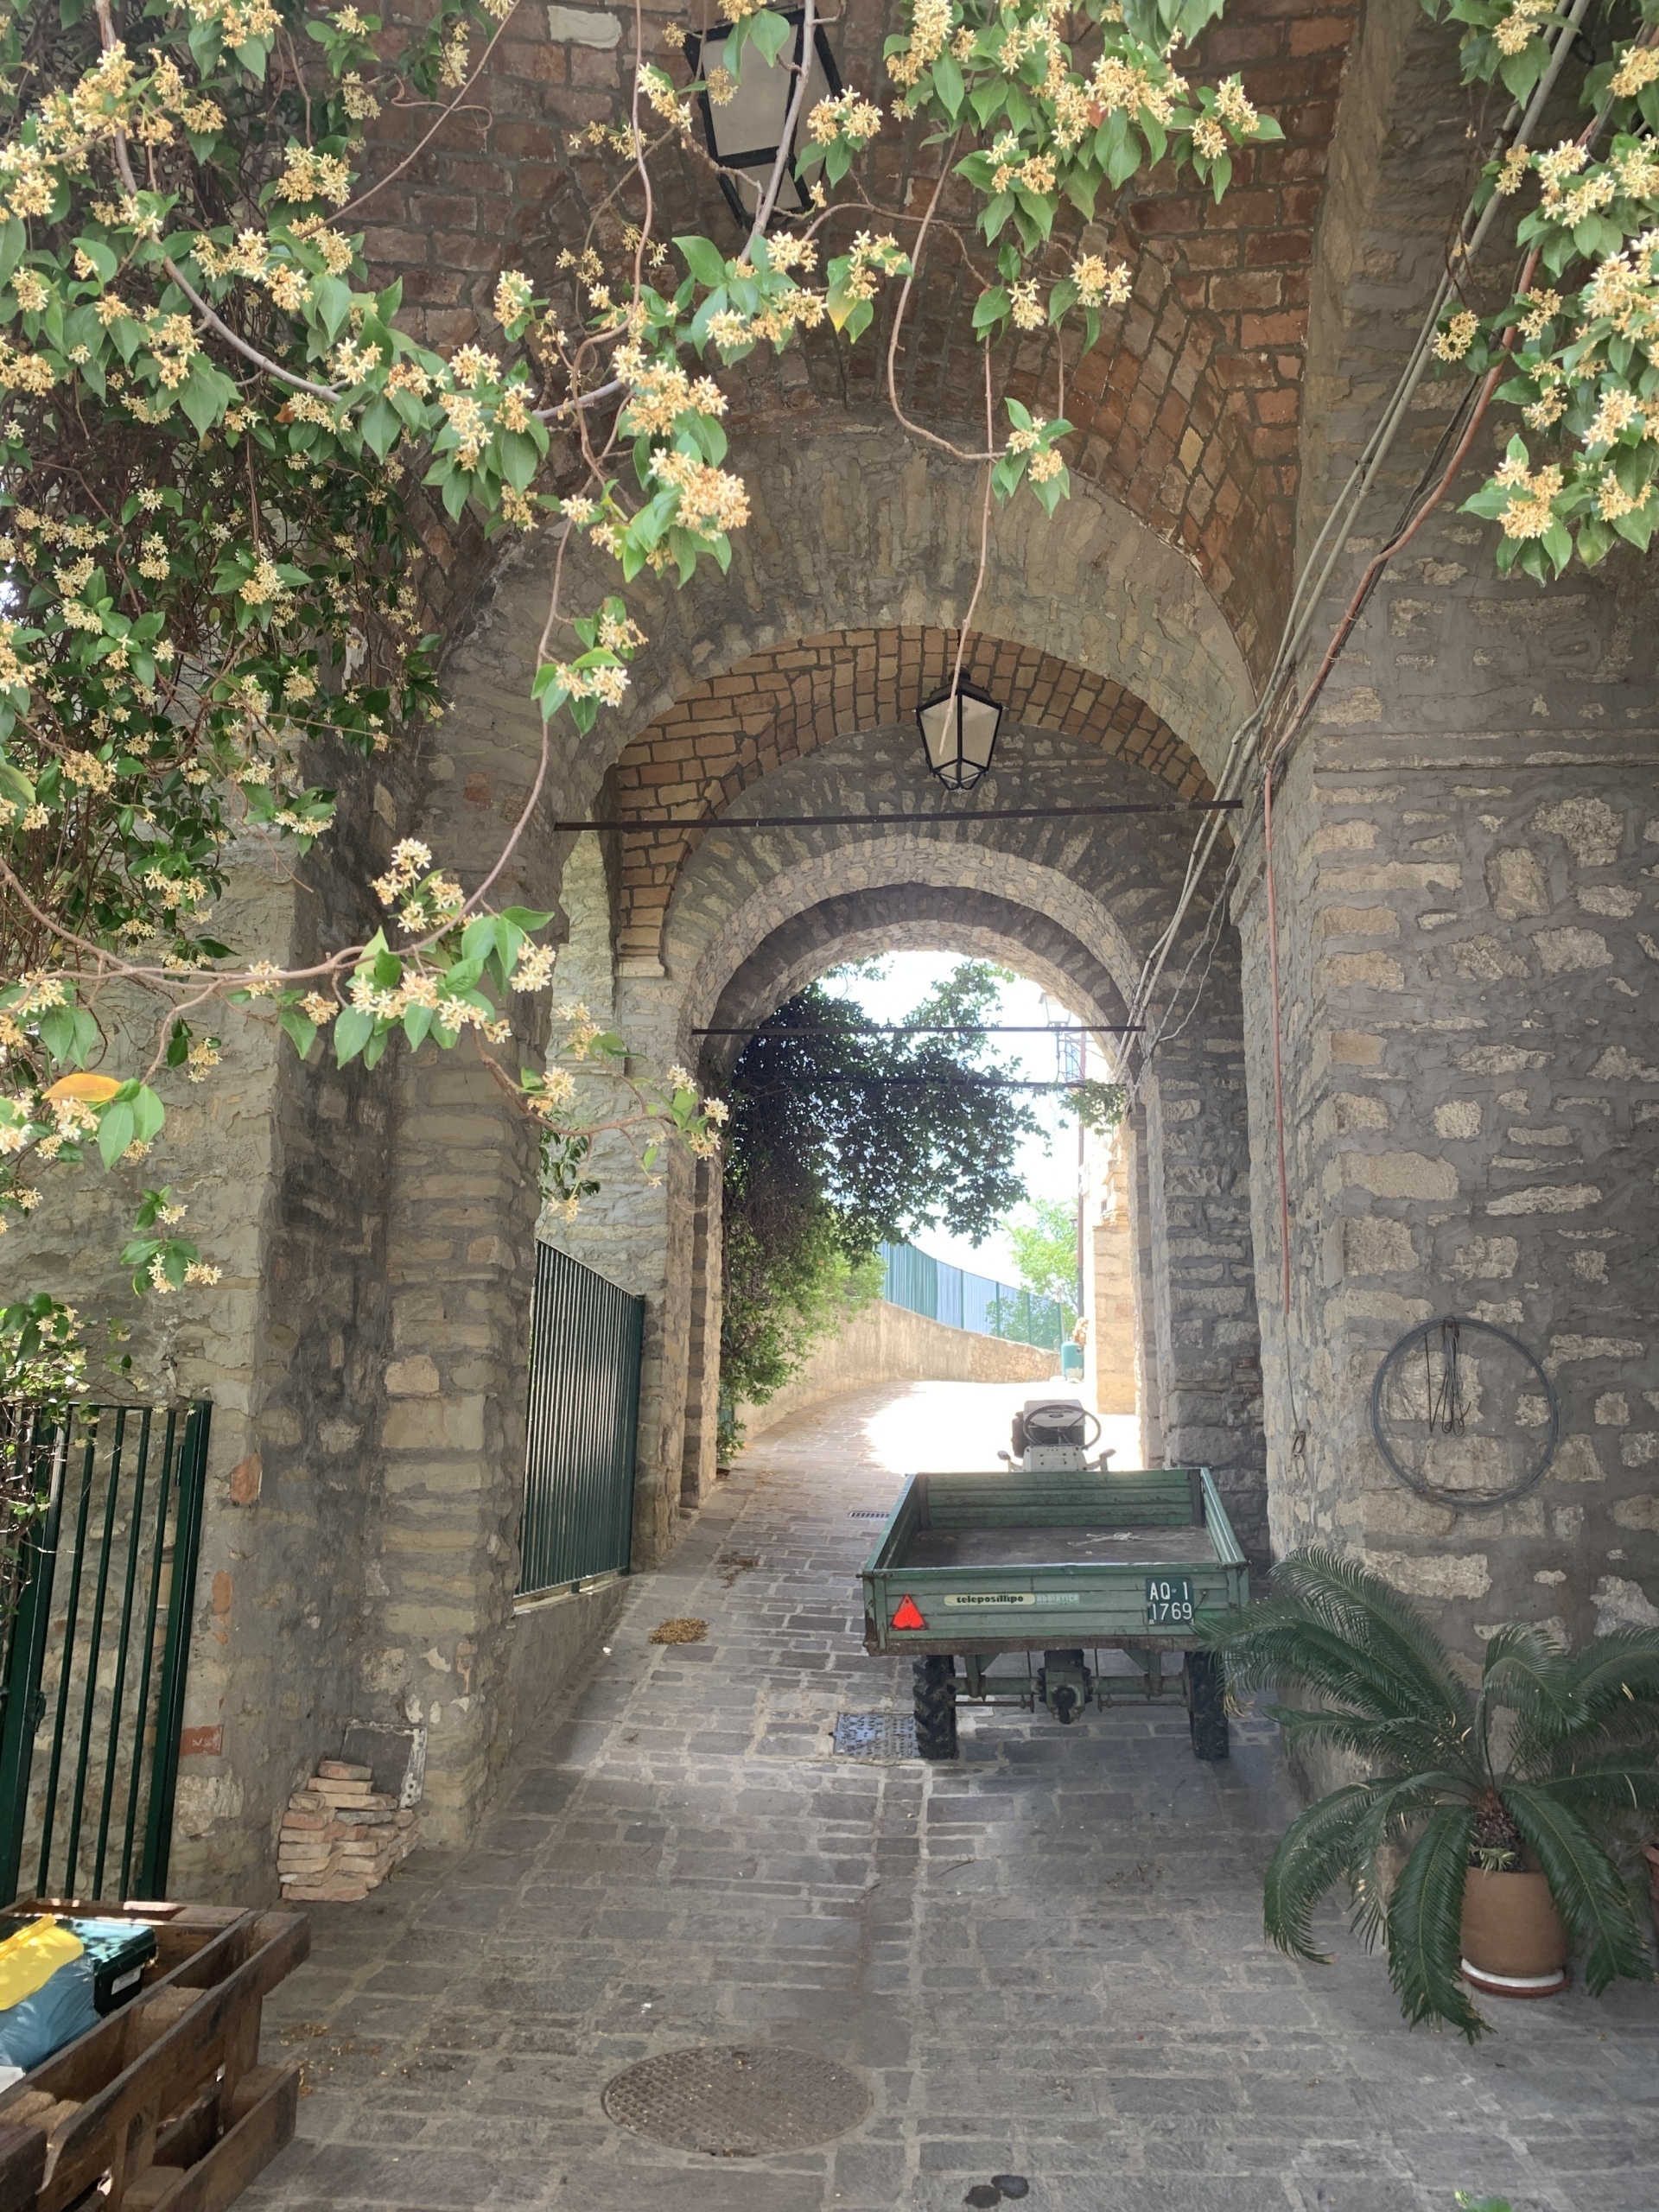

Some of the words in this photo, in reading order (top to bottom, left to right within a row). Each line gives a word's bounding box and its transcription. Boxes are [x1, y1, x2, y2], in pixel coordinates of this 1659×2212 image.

[1150, 1582, 1170, 1600] AQ
[1183, 1581, 1188, 1600] 1
[957, 1595, 1024, 1605] teleposillipo
[1153, 1602, 1192, 1620] 1769
